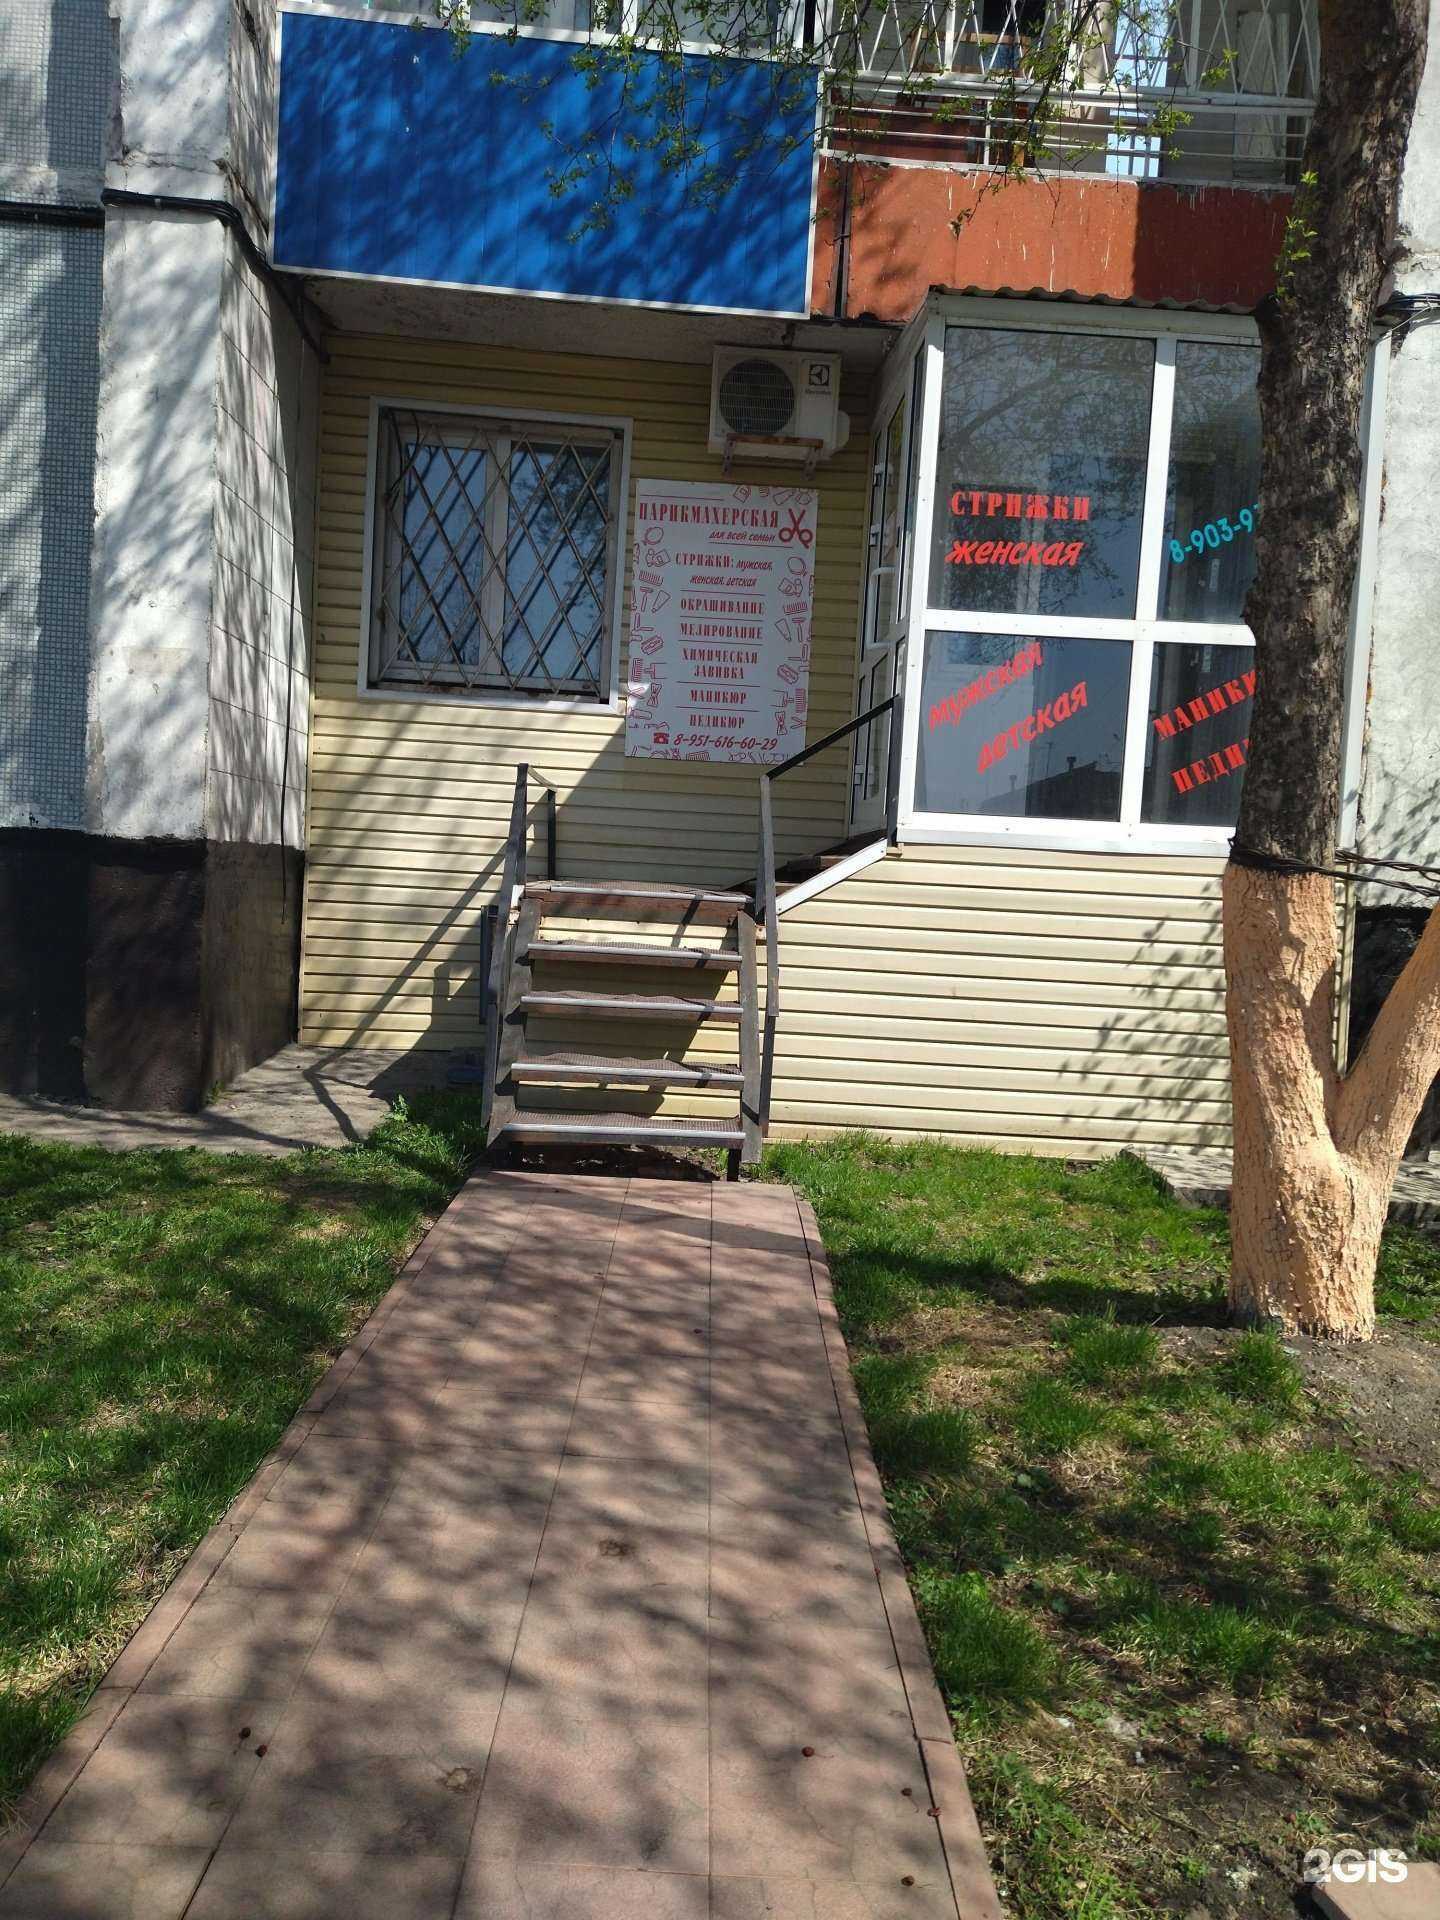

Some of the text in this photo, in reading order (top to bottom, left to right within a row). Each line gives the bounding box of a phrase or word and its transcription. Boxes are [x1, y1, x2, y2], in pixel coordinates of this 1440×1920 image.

[950, 490, 1091, 521] СТРИЖКИ
[639, 502, 779, 528] ПАРИКМАХЕРСКАЯ
[1169, 503, 1260, 563] 8-903-9
[675, 552, 734, 569] СТРИЖКИ:
[945, 540, 1085, 568] женская
[680, 599, 765, 615] ОКРАШИВАНИЕ
[680, 623, 763, 640] МЕЛИРОВАНИЕ
[683, 648, 758, 664] ХИМИЧЕСКАЯ
[694, 665, 744, 679] ЗАВИВКА
[690, 689, 747, 705] МАНИКЮР
[928, 641, 1044, 736] мужская
[689, 714, 745, 729] ПЕДИКЮР
[977, 681, 1088, 775] детская
[673, 734, 778, 750] 8-951-616-60-29
[1170, 738, 1251, 794] ПЕДИ
